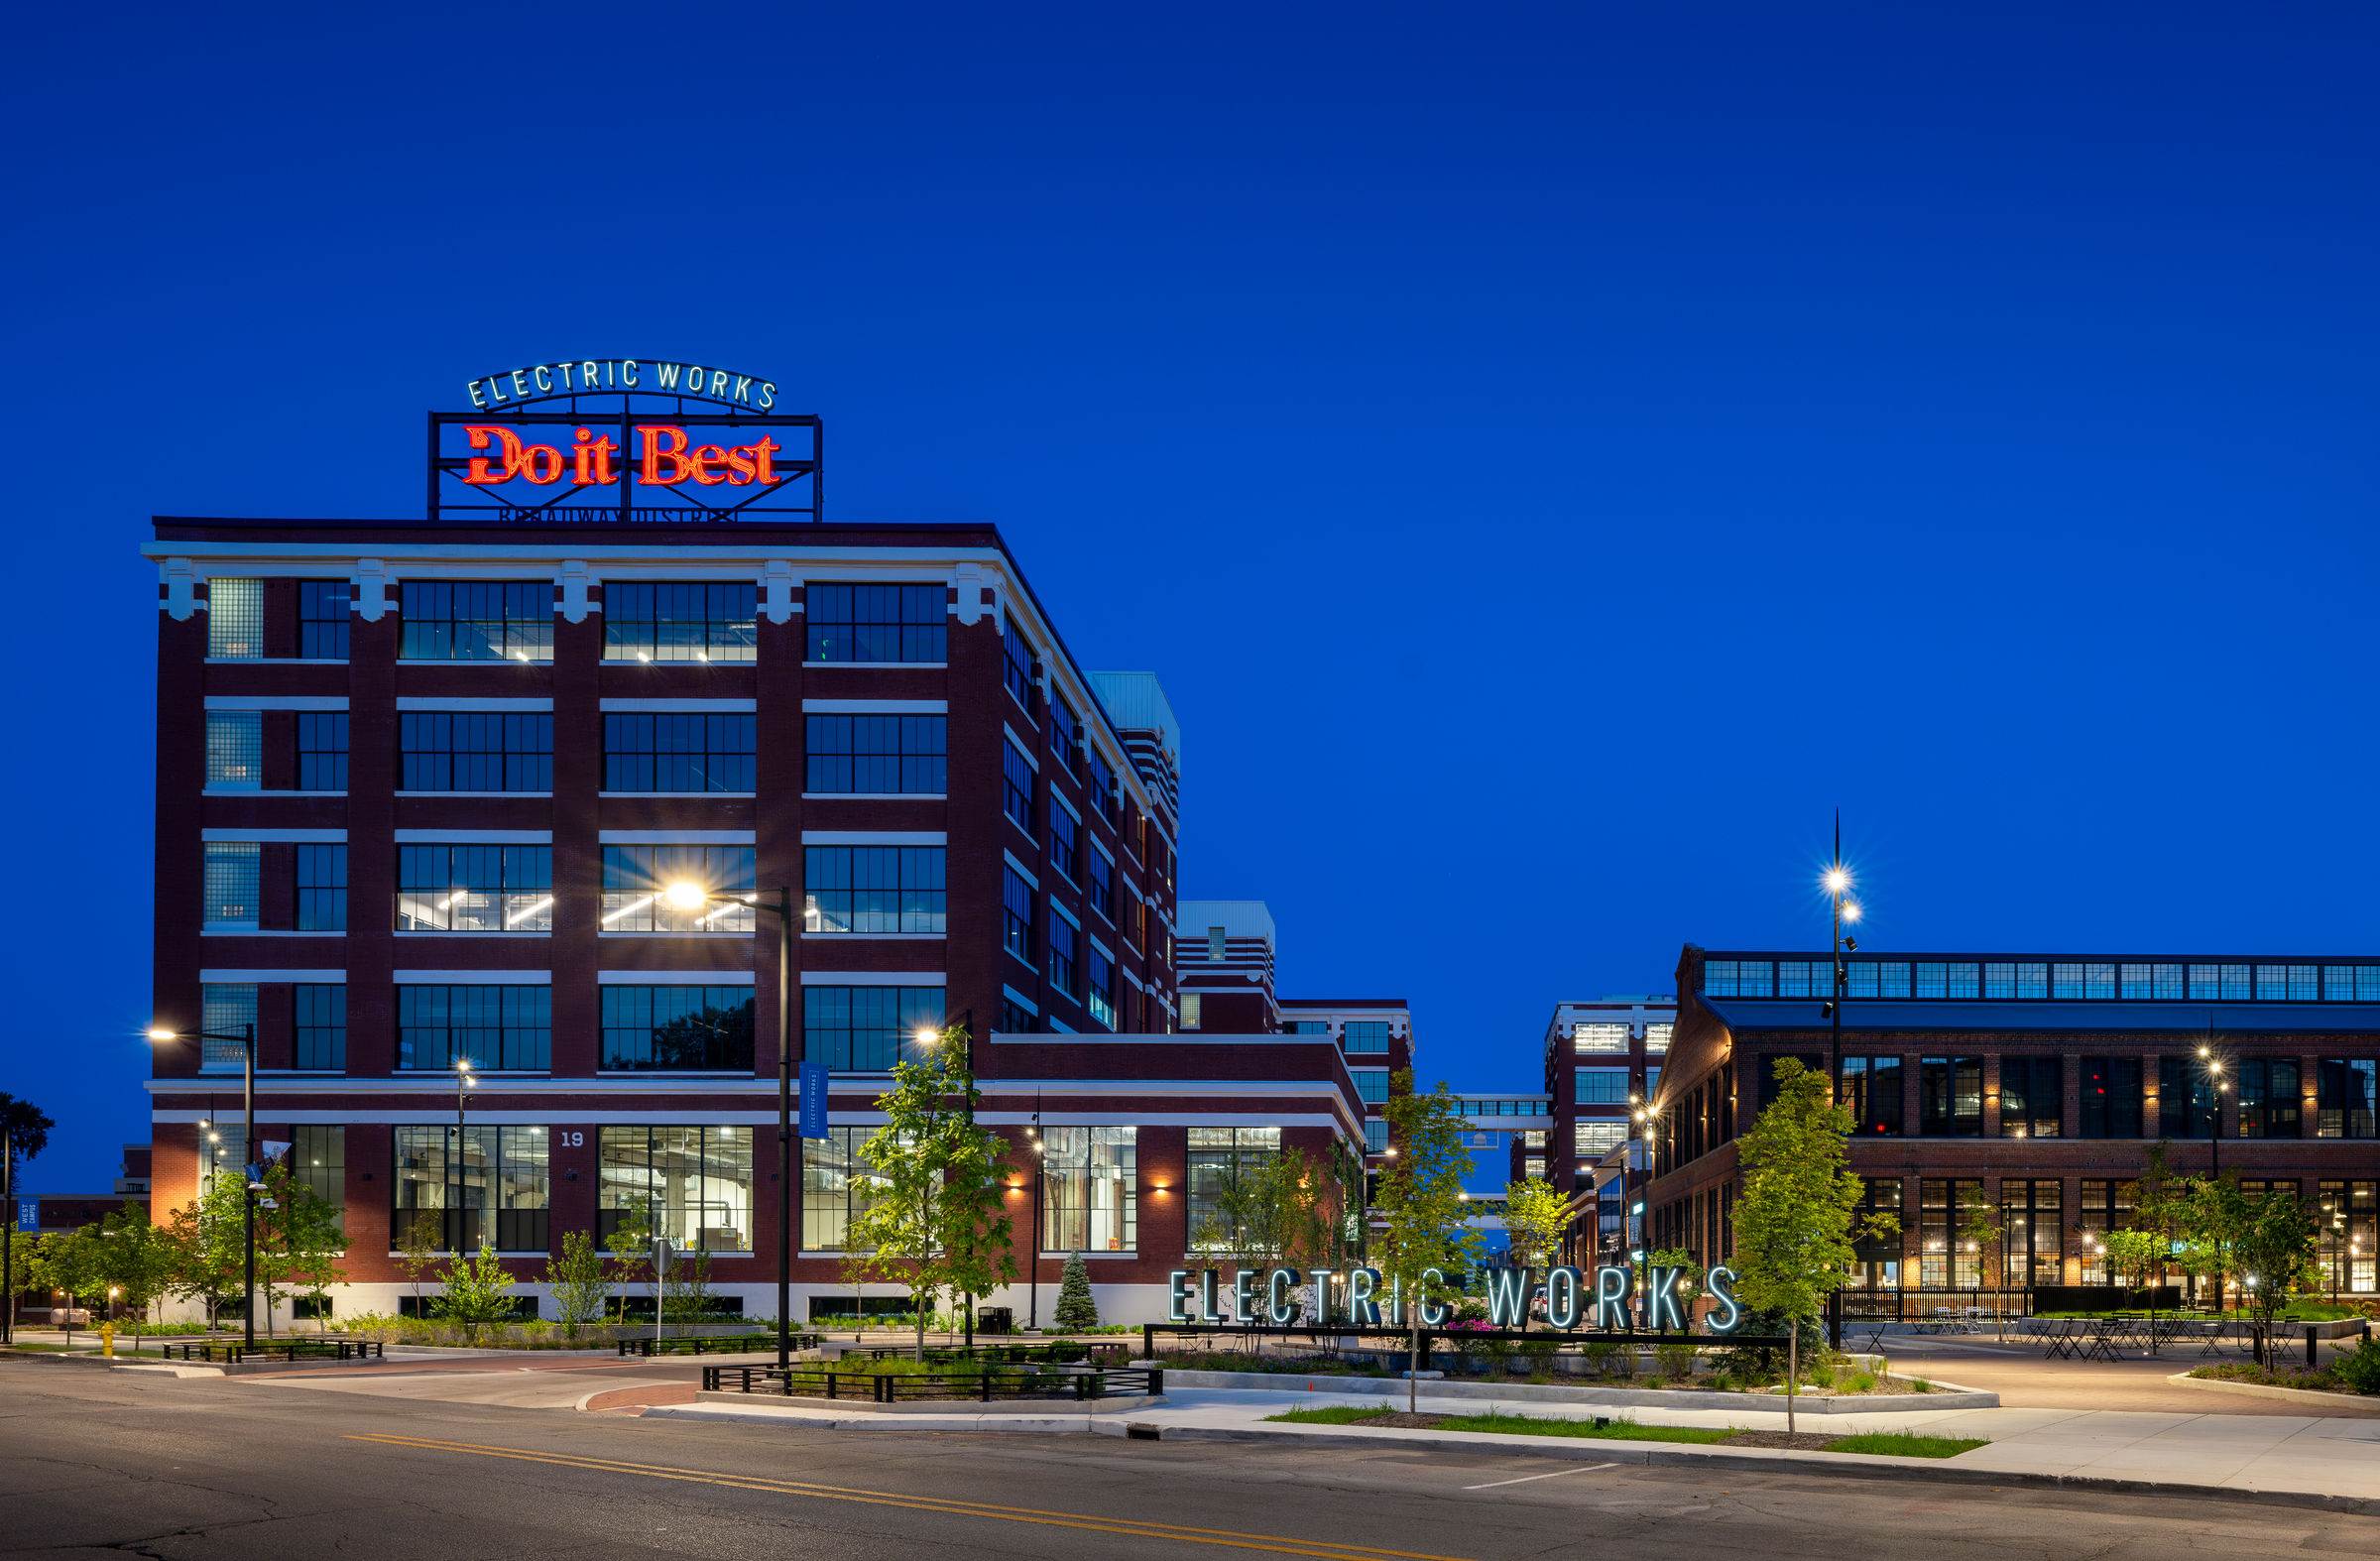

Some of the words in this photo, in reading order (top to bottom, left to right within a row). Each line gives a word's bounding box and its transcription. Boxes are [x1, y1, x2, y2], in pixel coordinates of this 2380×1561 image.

[468, 360, 641, 408] ELECTRIC
[657, 362, 778, 410] WORKS
[462, 424, 563, 485] Do
[571, 426, 621, 486] it
[636, 424, 781, 486] Best
[561, 1132, 583, 1147] 19
[1169, 1266, 1454, 1327] ELECTRIC
[1486, 1264, 1743, 1331] WORKS
